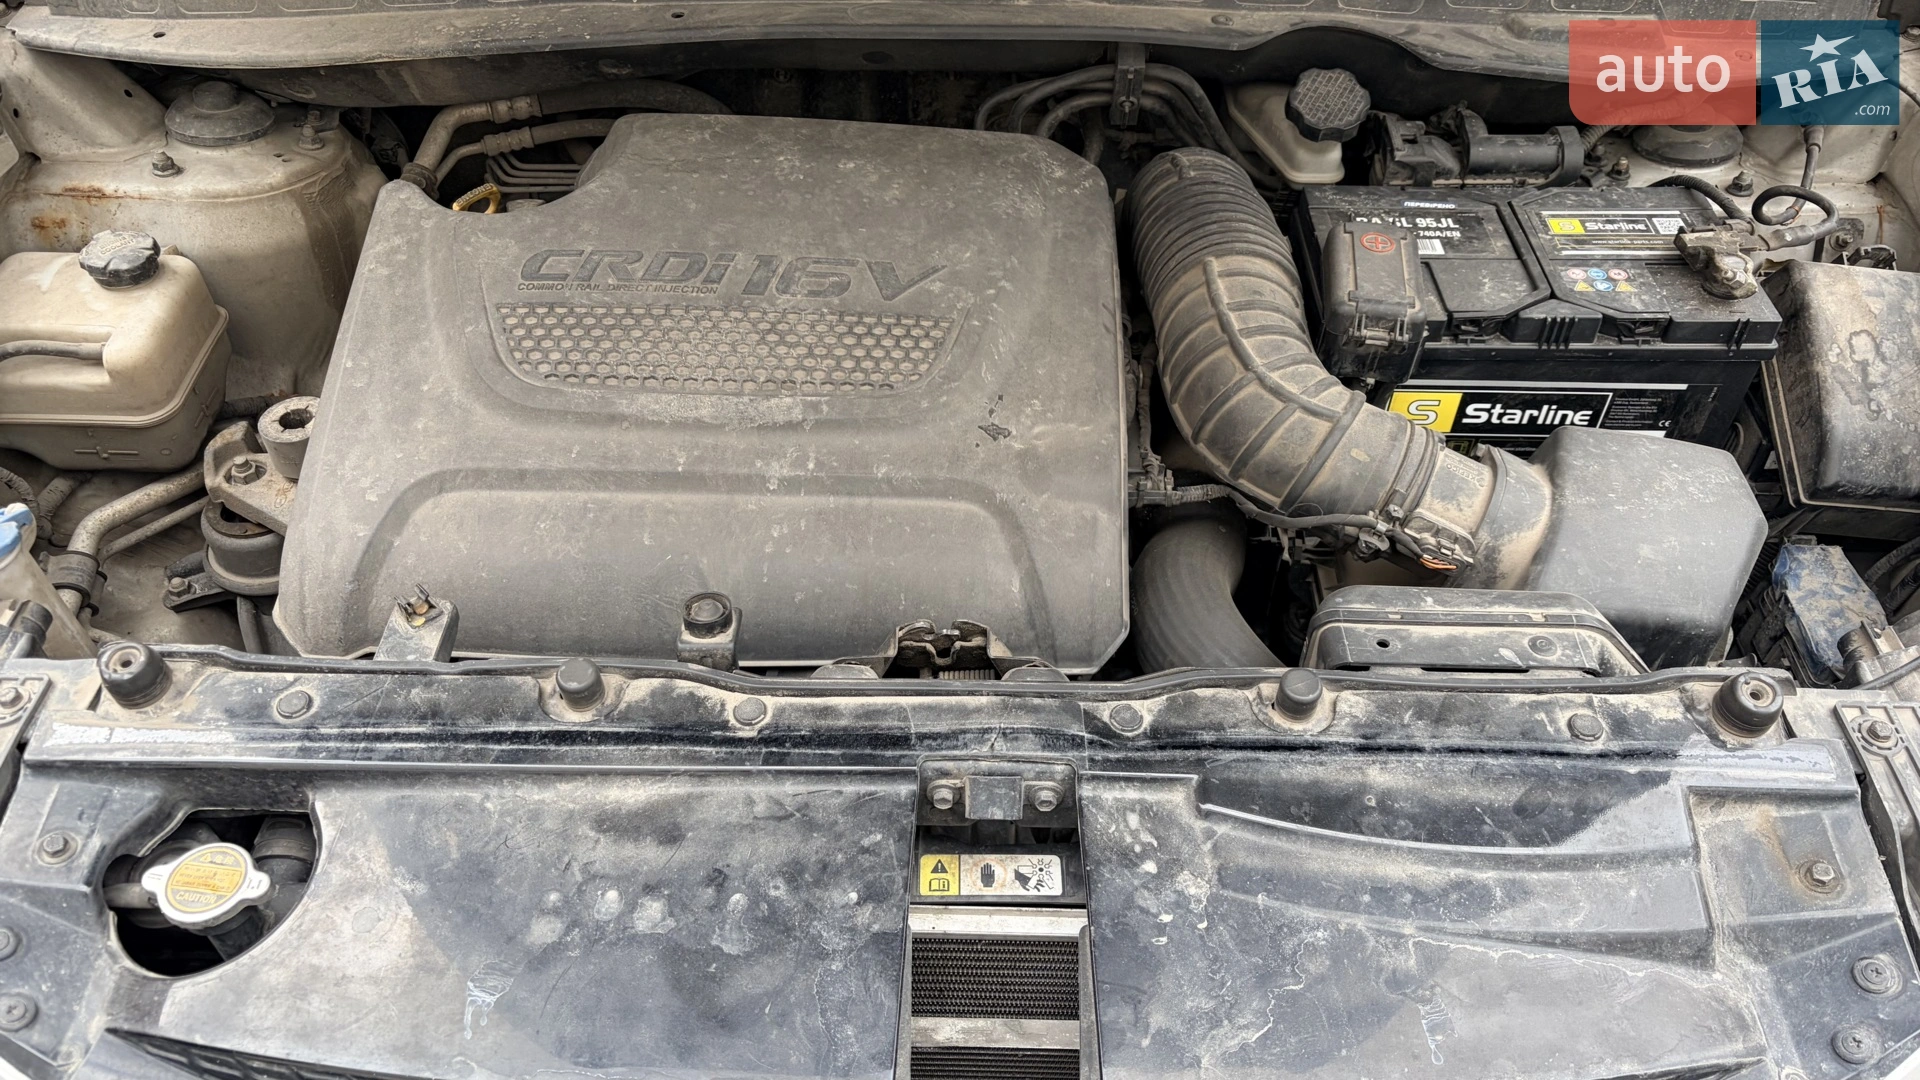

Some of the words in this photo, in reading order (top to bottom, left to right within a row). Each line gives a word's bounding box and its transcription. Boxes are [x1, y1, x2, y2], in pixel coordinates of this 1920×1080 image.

[1403, 201, 1456, 210] ПЕРЕВІРЕНО
[1415, 217, 1460, 228] 95JL
[1585, 222, 1647, 231] Starline
[1418, 230, 1462, 238] 740A/EN
[520, 249, 736, 284] CRDi
[740, 254, 948, 301] 16V
[517, 283, 573, 291] COMMON
[606, 284, 649, 292] DIRECT
[653, 285, 719, 294] INJECTION
[1461, 403, 1593, 426] Starline
[175, 891, 218, 904] CAUTION
